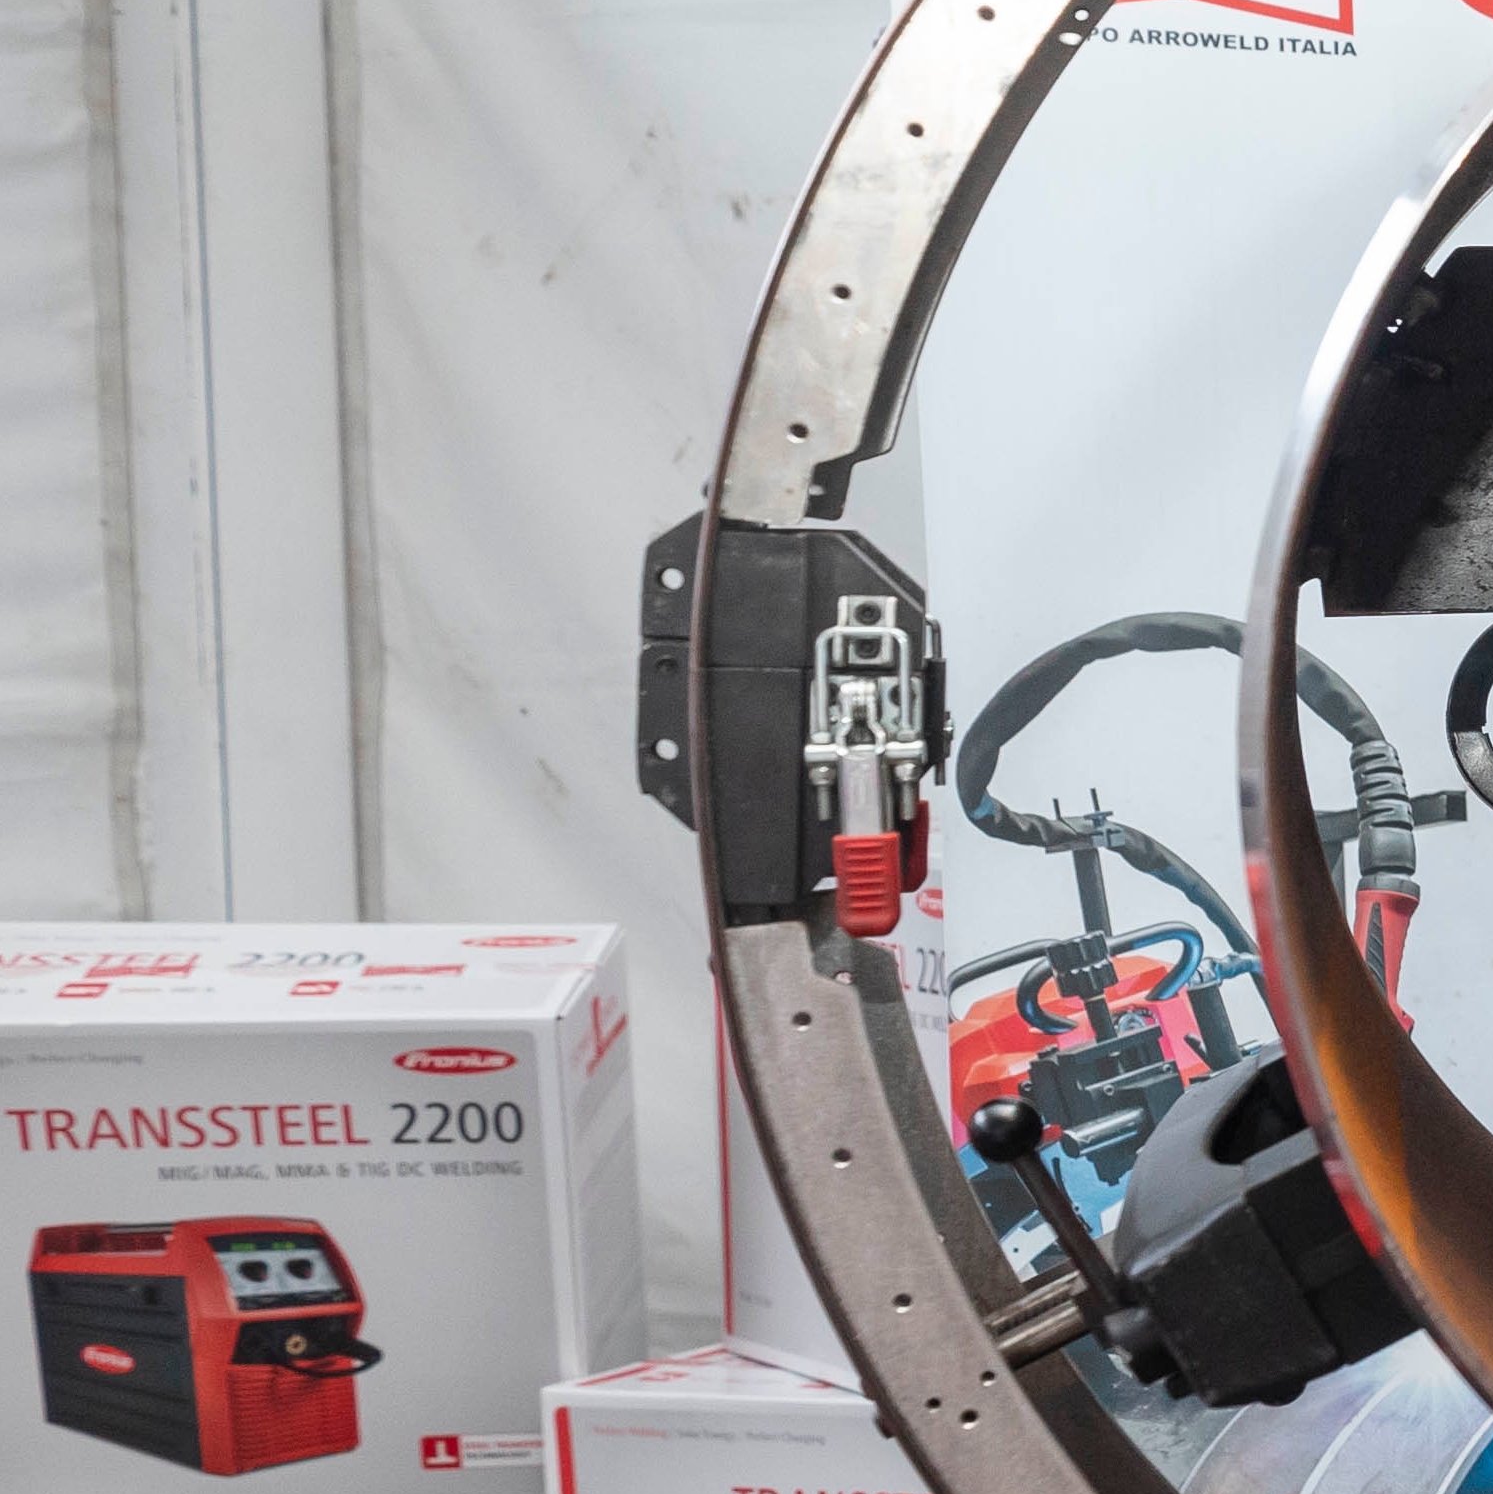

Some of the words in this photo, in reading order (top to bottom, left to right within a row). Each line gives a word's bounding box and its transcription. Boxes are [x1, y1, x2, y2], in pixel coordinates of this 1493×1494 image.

[1129, 29, 1269, 52] ARROWELD
[1279, 37, 1357, 56] ITALIA
[916, 946, 947, 996] 22
[8, 1104, 371, 1152] TRANSSTEEL
[389, 1102, 525, 1144] 2200
